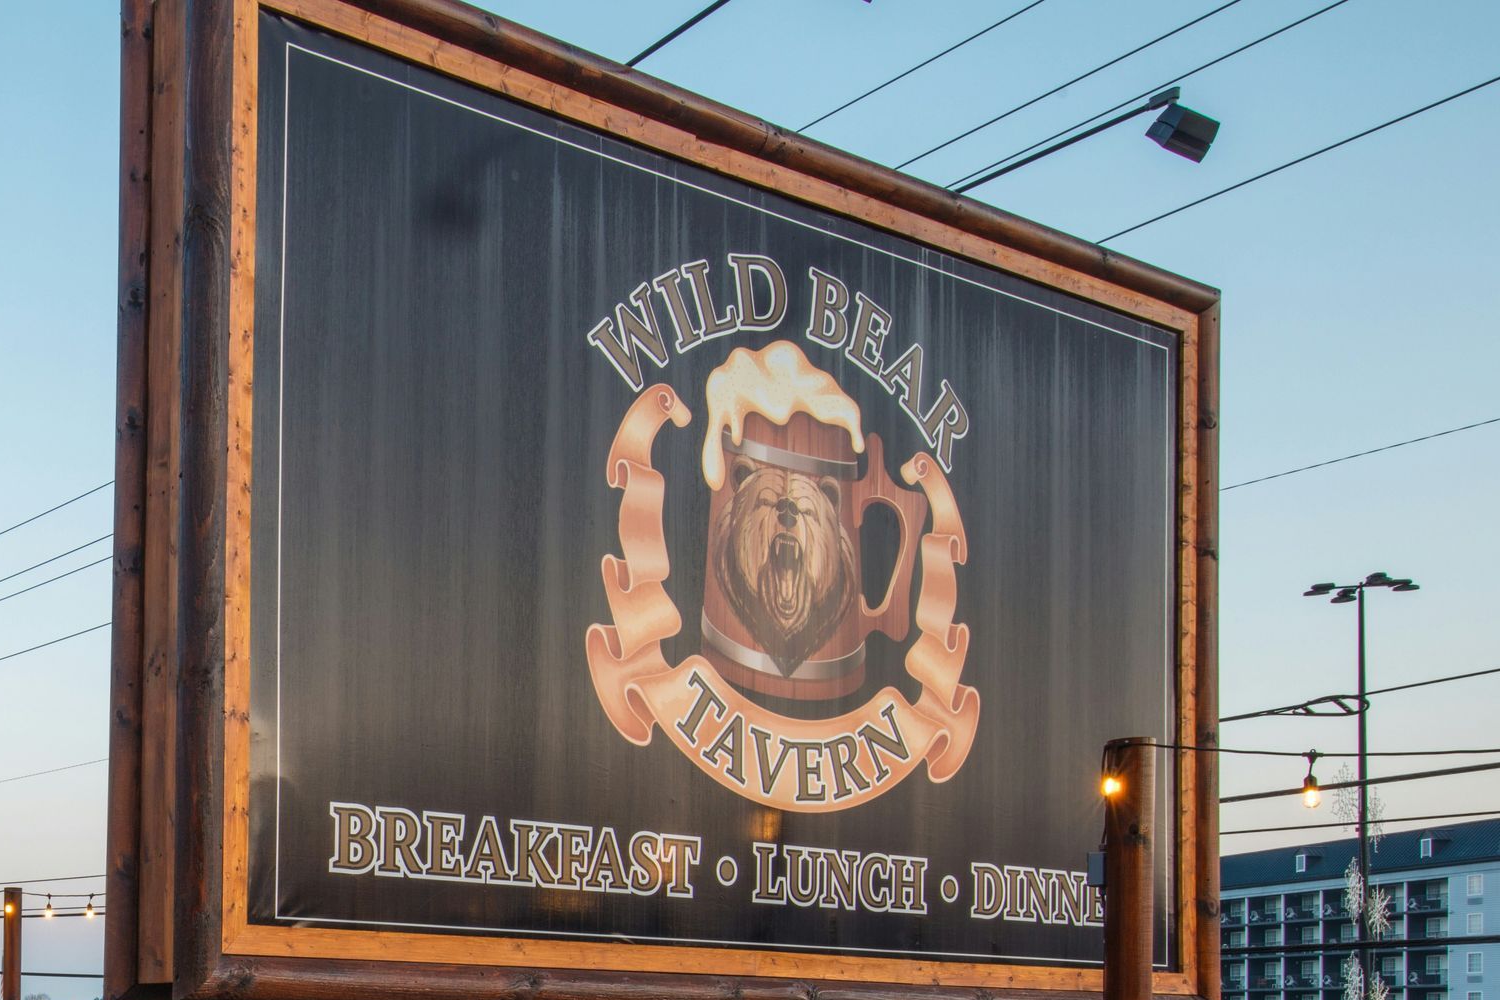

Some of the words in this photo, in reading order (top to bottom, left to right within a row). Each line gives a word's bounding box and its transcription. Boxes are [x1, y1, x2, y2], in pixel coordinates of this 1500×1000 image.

[588, 253, 788, 392] WILD
[808, 268, 969, 471] BEAR
[675, 670, 912, 802] TAVERN
[329, 802, 701, 898] BREAKFAST
[752, 842, 929, 914] LUNCH
